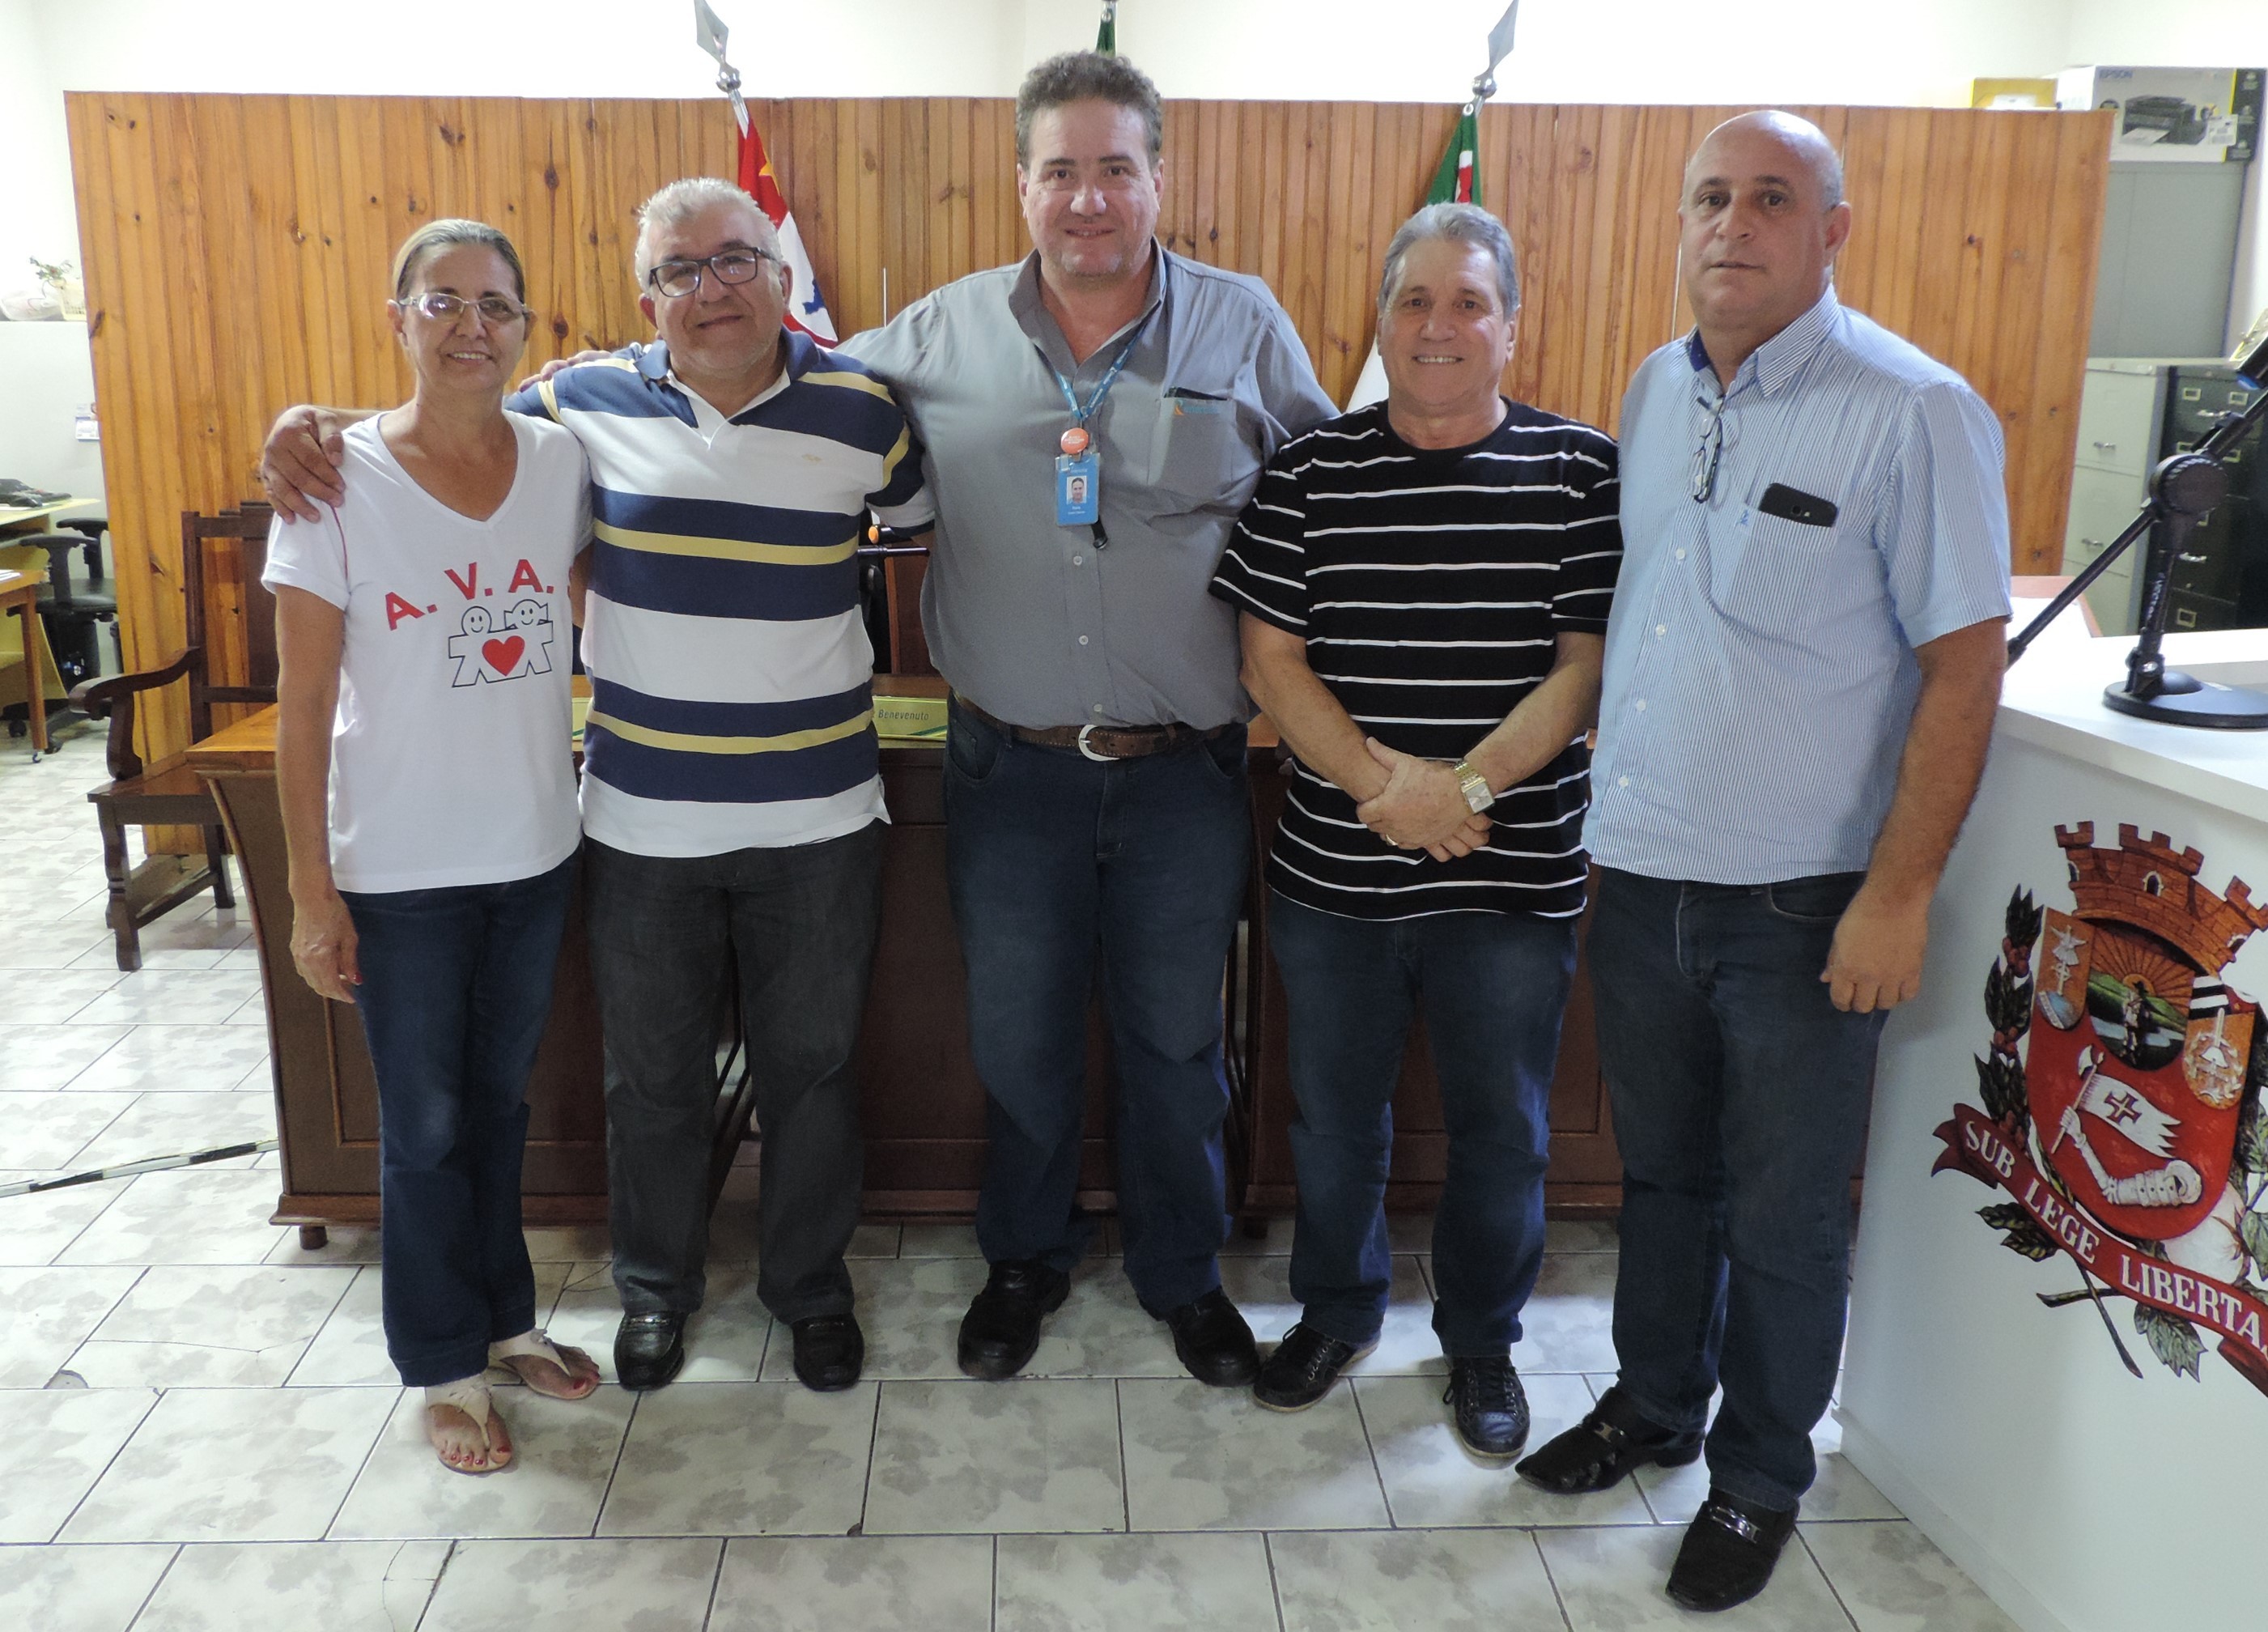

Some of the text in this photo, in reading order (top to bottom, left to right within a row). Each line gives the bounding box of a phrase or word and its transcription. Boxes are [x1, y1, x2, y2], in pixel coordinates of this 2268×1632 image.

[878, 709, 929, 720] Benevenuto
[1965, 1120, 2268, 1362] SUB LEGE LIBERTA
